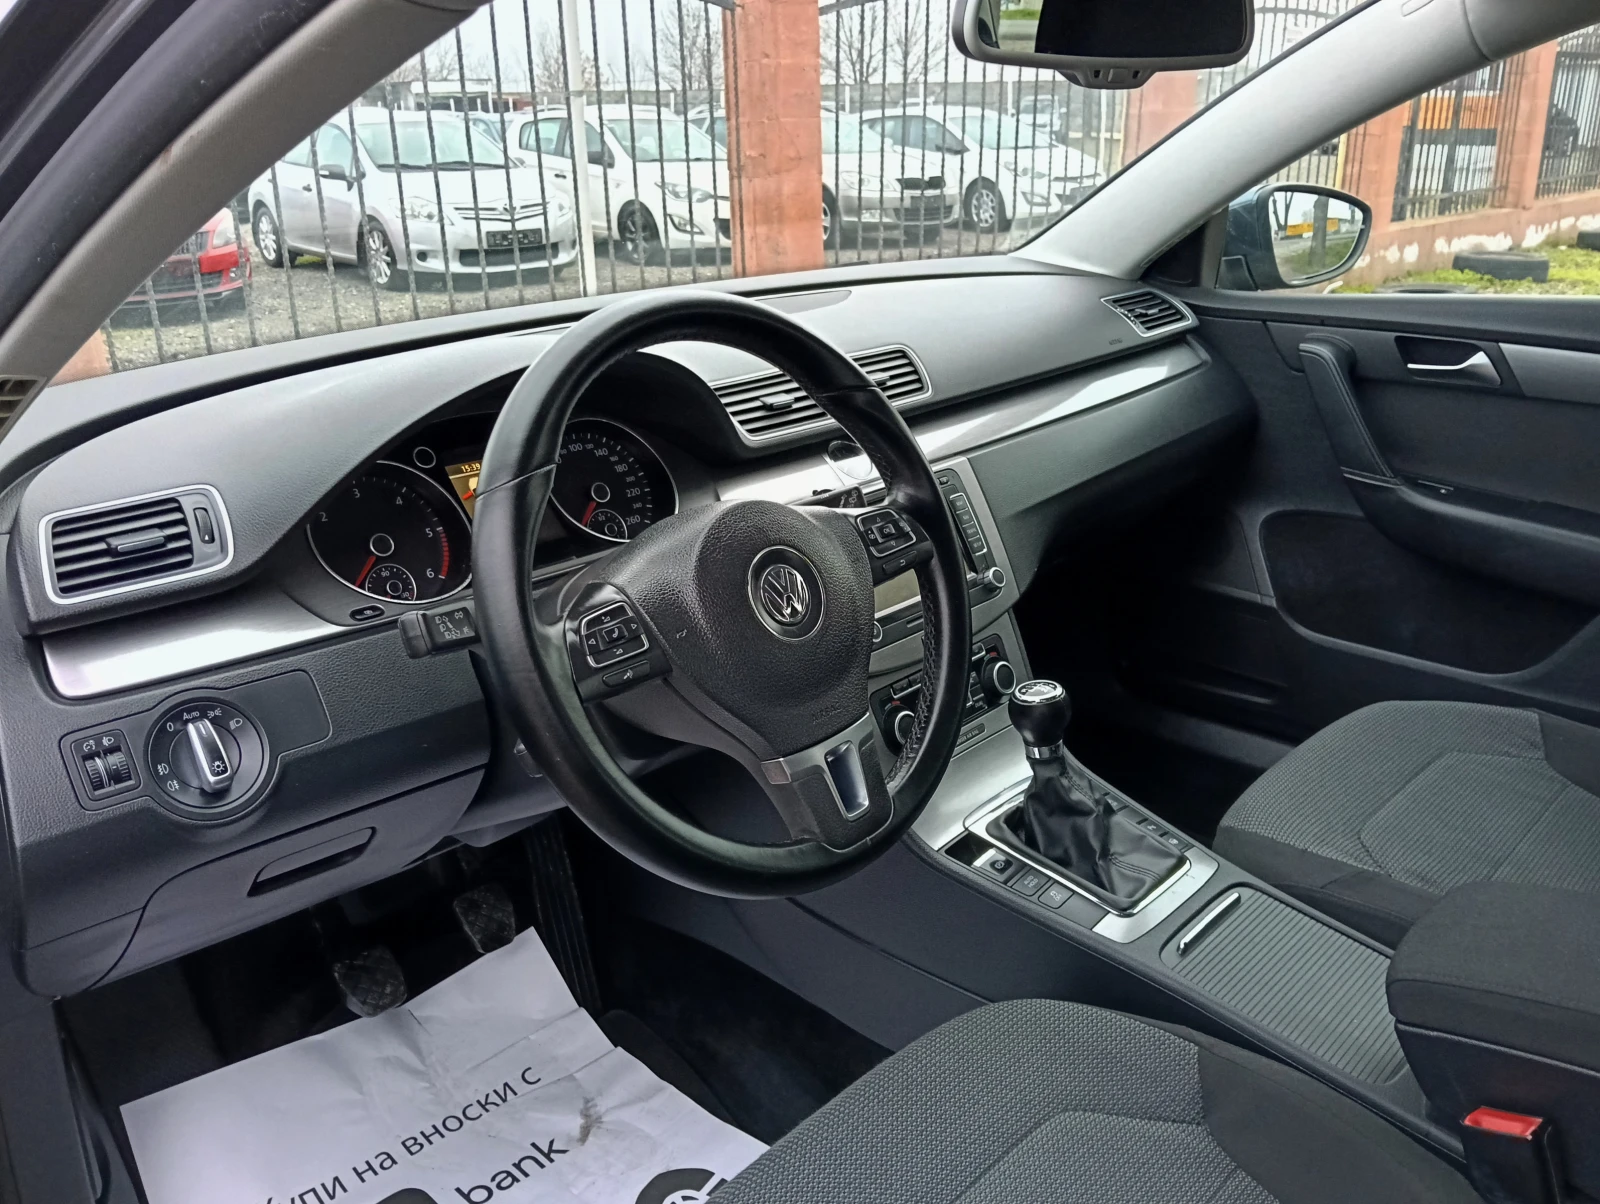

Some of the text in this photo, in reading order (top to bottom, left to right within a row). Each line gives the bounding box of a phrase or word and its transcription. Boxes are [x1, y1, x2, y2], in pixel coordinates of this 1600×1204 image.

[568, 442, 583, 452] 100
[594, 448, 608, 456] 140
[614, 463, 628, 473] 180
[352, 488, 361, 499] 3
[626, 488, 640, 497] 220
[395, 496, 403, 506] 4
[318, 512, 329, 522] 2
[626, 514, 641, 525] 260
[425, 527, 433, 538] 5
[426, 568, 435, 578] 6
[351, 1151, 399, 1184] на
[400, 1081, 519, 1157] вноски
[520, 1067, 542, 1085] с
[454, 1138, 570, 1204] bank
